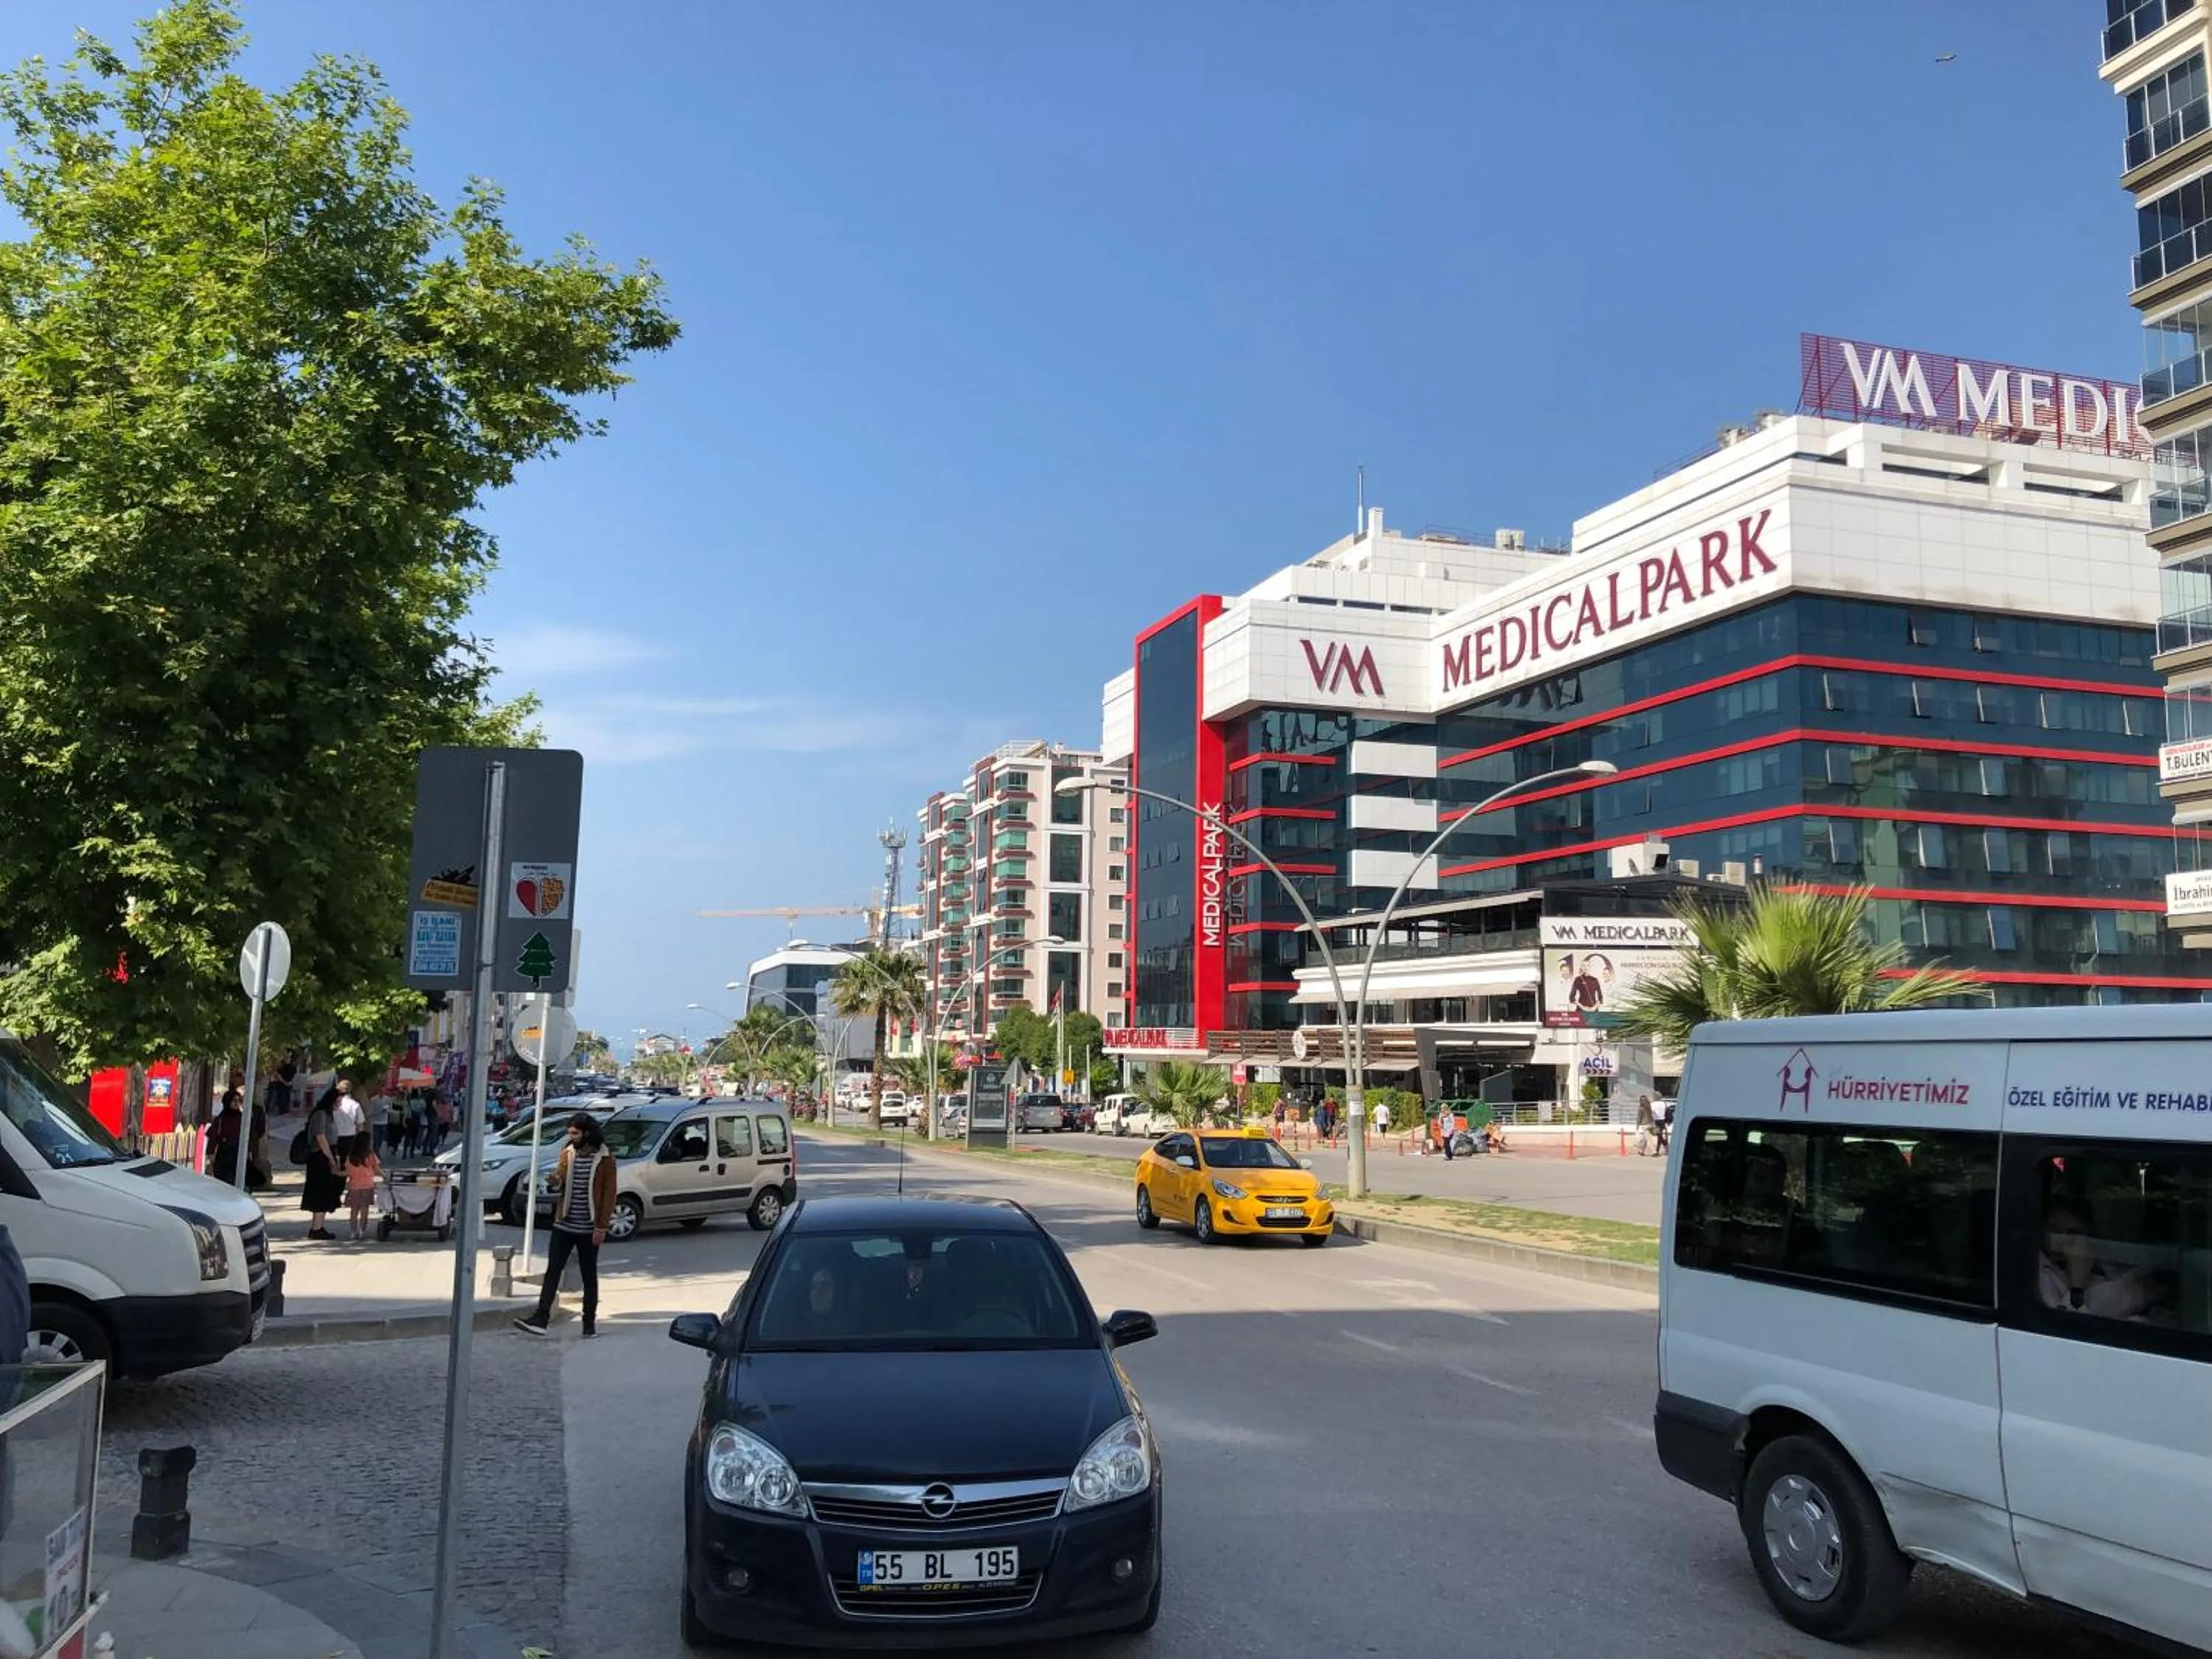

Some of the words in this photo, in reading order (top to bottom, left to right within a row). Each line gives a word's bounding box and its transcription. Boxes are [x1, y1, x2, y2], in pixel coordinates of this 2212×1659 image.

[1840, 342, 1937, 417] VM
[1299, 639, 1385, 697] VM
[1443, 509, 1778, 693] MEDICALPARK
[2166, 751, 2212, 771] T.BÜLEN
[2174, 885, 2212, 901] İbrahi
[1583, 925, 1691, 941] MEDICALPARK
[1583, 1055, 1613, 1068] ACİL
[1828, 1075, 1970, 1105] HÜRRİYETİMİZ
[2008, 1086, 2046, 1107] ÖZEL
[2053, 1086, 2110, 1108] EĞİTİM
[2118, 1091, 2138, 1110] VE
[875, 1554, 902, 1579] 55
[925, 1553, 953, 1579] BL
[974, 1549, 1015, 1578] 195
